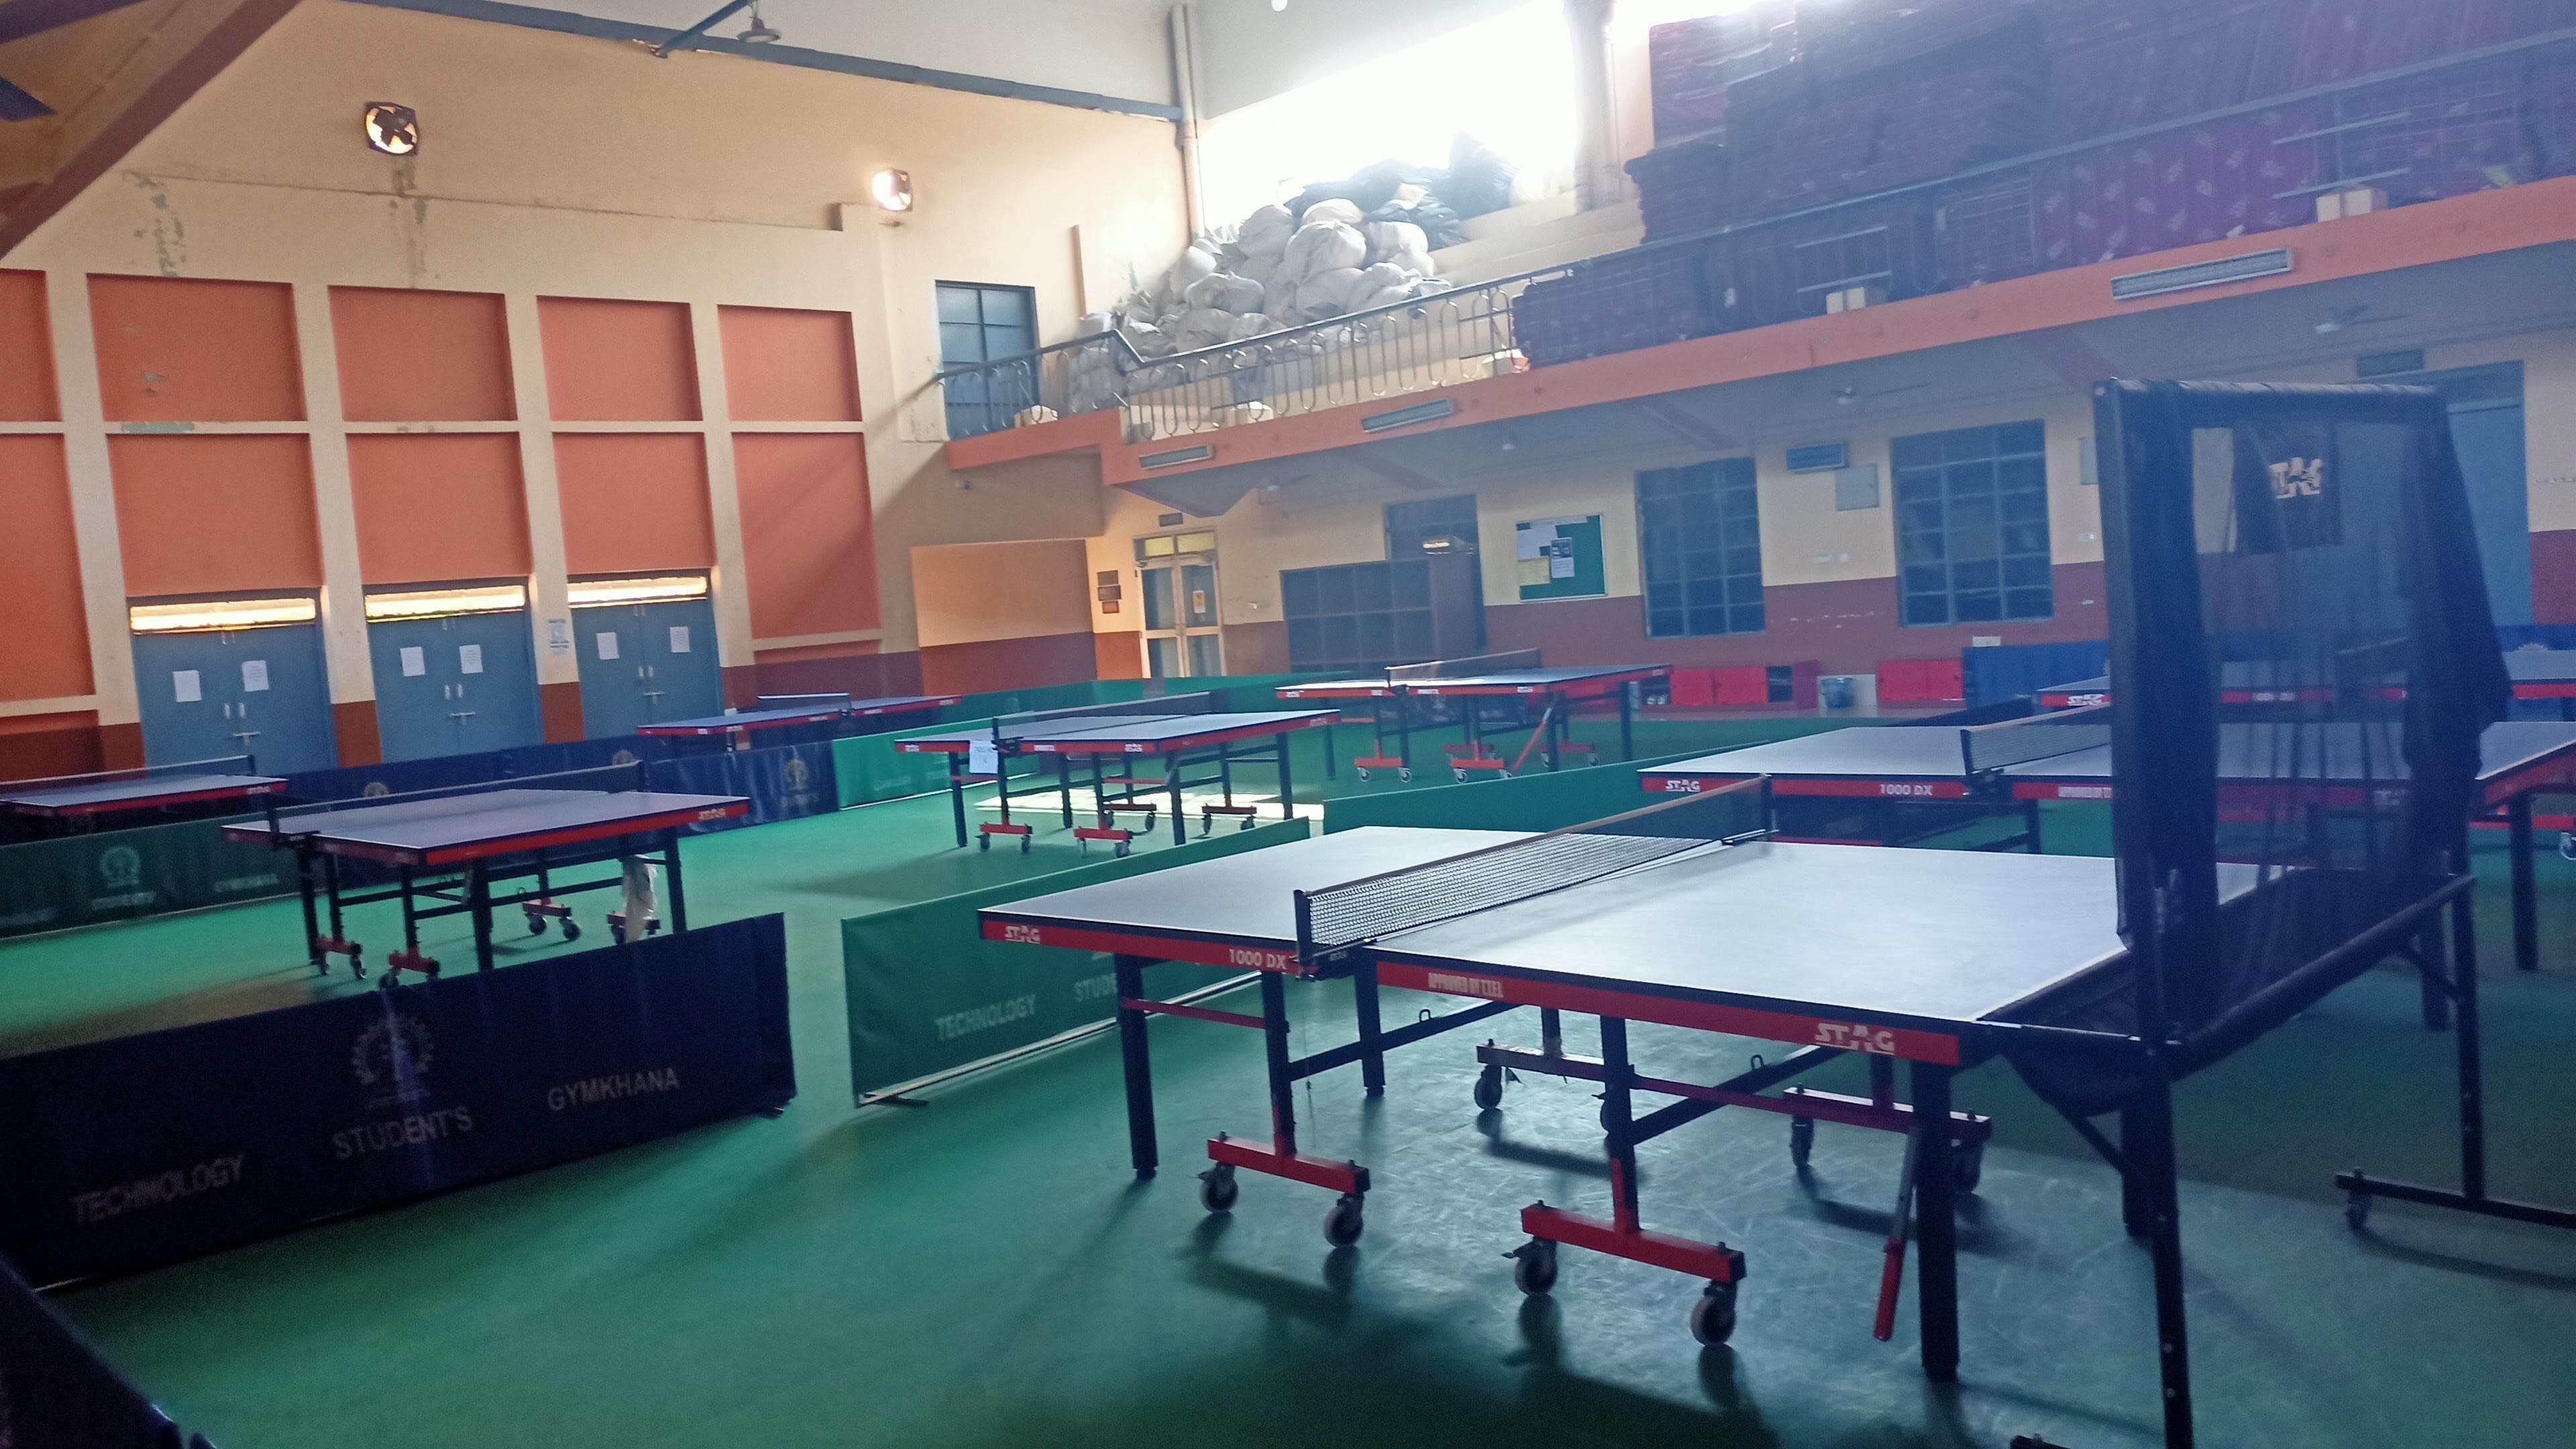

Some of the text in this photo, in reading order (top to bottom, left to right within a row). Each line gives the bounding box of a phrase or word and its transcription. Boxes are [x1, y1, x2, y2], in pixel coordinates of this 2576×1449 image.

[1665, 779, 1701, 792] STAG
[1880, 784, 1933, 796] 1000 DX
[1004, 925, 1041, 945] STAG
[1229, 949, 1288, 970] 1000 DX
[934, 994, 1036, 1040] TECHNOLOGY
[1814, 1022, 1896, 1055] STAG
[72, 1153, 244, 1225] TECHNOLOGY
[547, 1067, 682, 1112] GYMKHANA
